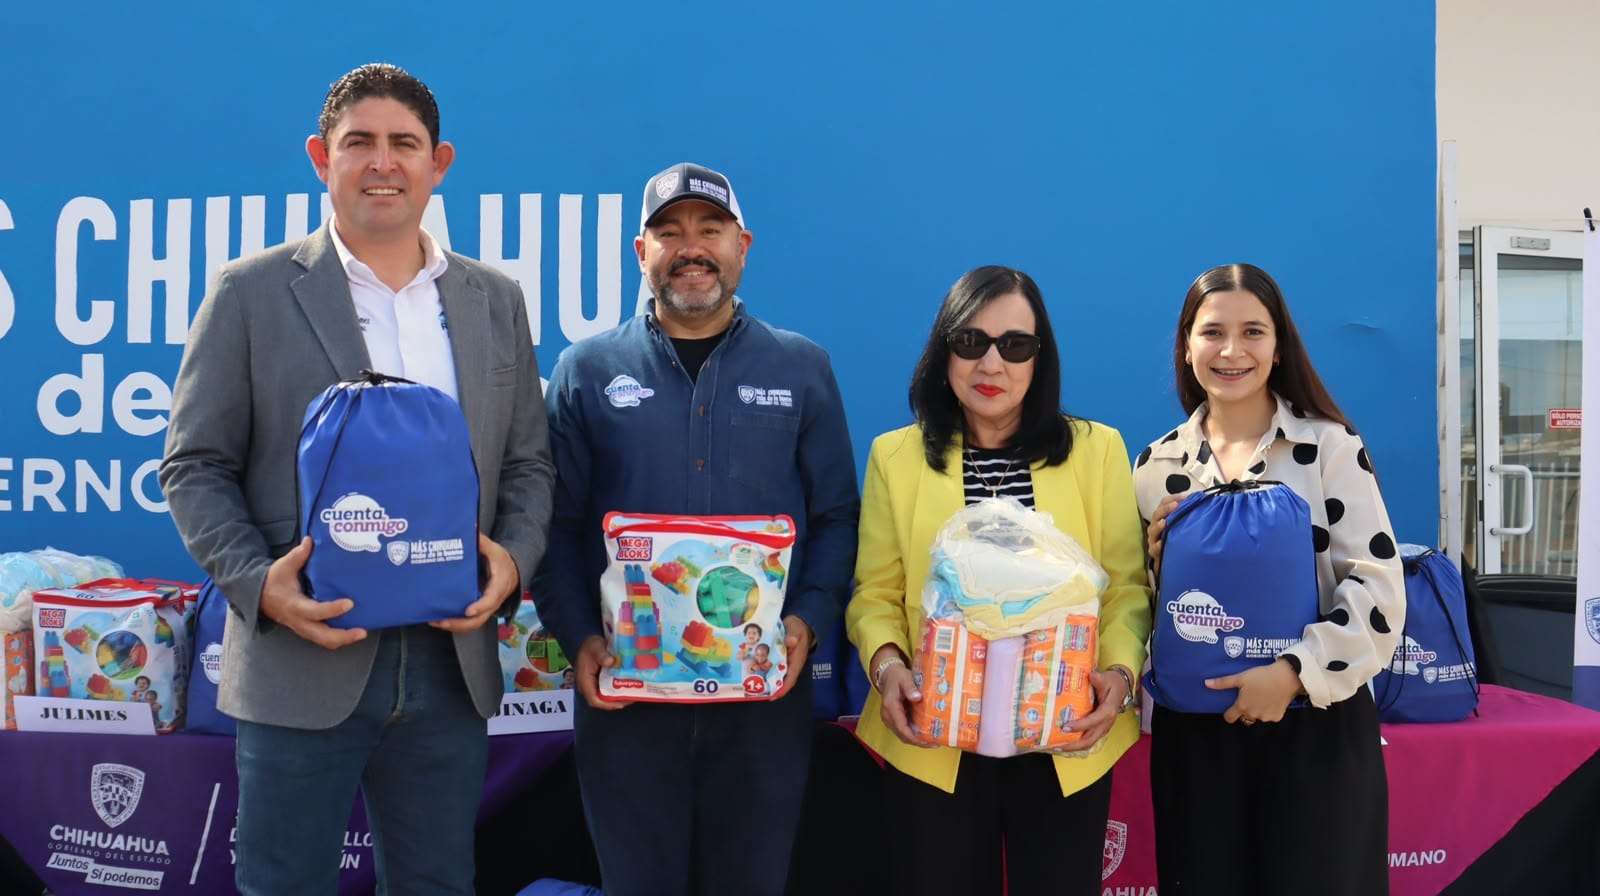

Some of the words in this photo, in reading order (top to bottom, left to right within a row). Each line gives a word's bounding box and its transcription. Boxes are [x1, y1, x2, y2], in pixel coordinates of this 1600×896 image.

[37, 353, 173, 437] de
[322, 507, 383, 521] cuenta
[334, 520, 406, 535] conmigo
[620, 537, 650, 547] MEGA
[618, 549, 649, 560] BLOKS
[41, 609, 66, 618] MEGA
[1168, 602, 1222, 617] cuenta
[1177, 614, 1243, 631] conmigo
[1247, 637, 1262, 649] MÁS
[694, 679, 719, 694] 60
[747, 680, 763, 691] 1+
[40, 707, 128, 721] JULIMES
[50, 824, 170, 856] CHIHUAHUA
[48, 842, 100, 857] GOBIERNO
[105, 851, 125, 860] DEL
[129, 854, 171, 865] ESTADO
[1388, 849, 1447, 867] MANO
[51, 855, 89, 870] Juntos
[90, 868, 104, 881] Sí
[103, 870, 160, 887] podemos
